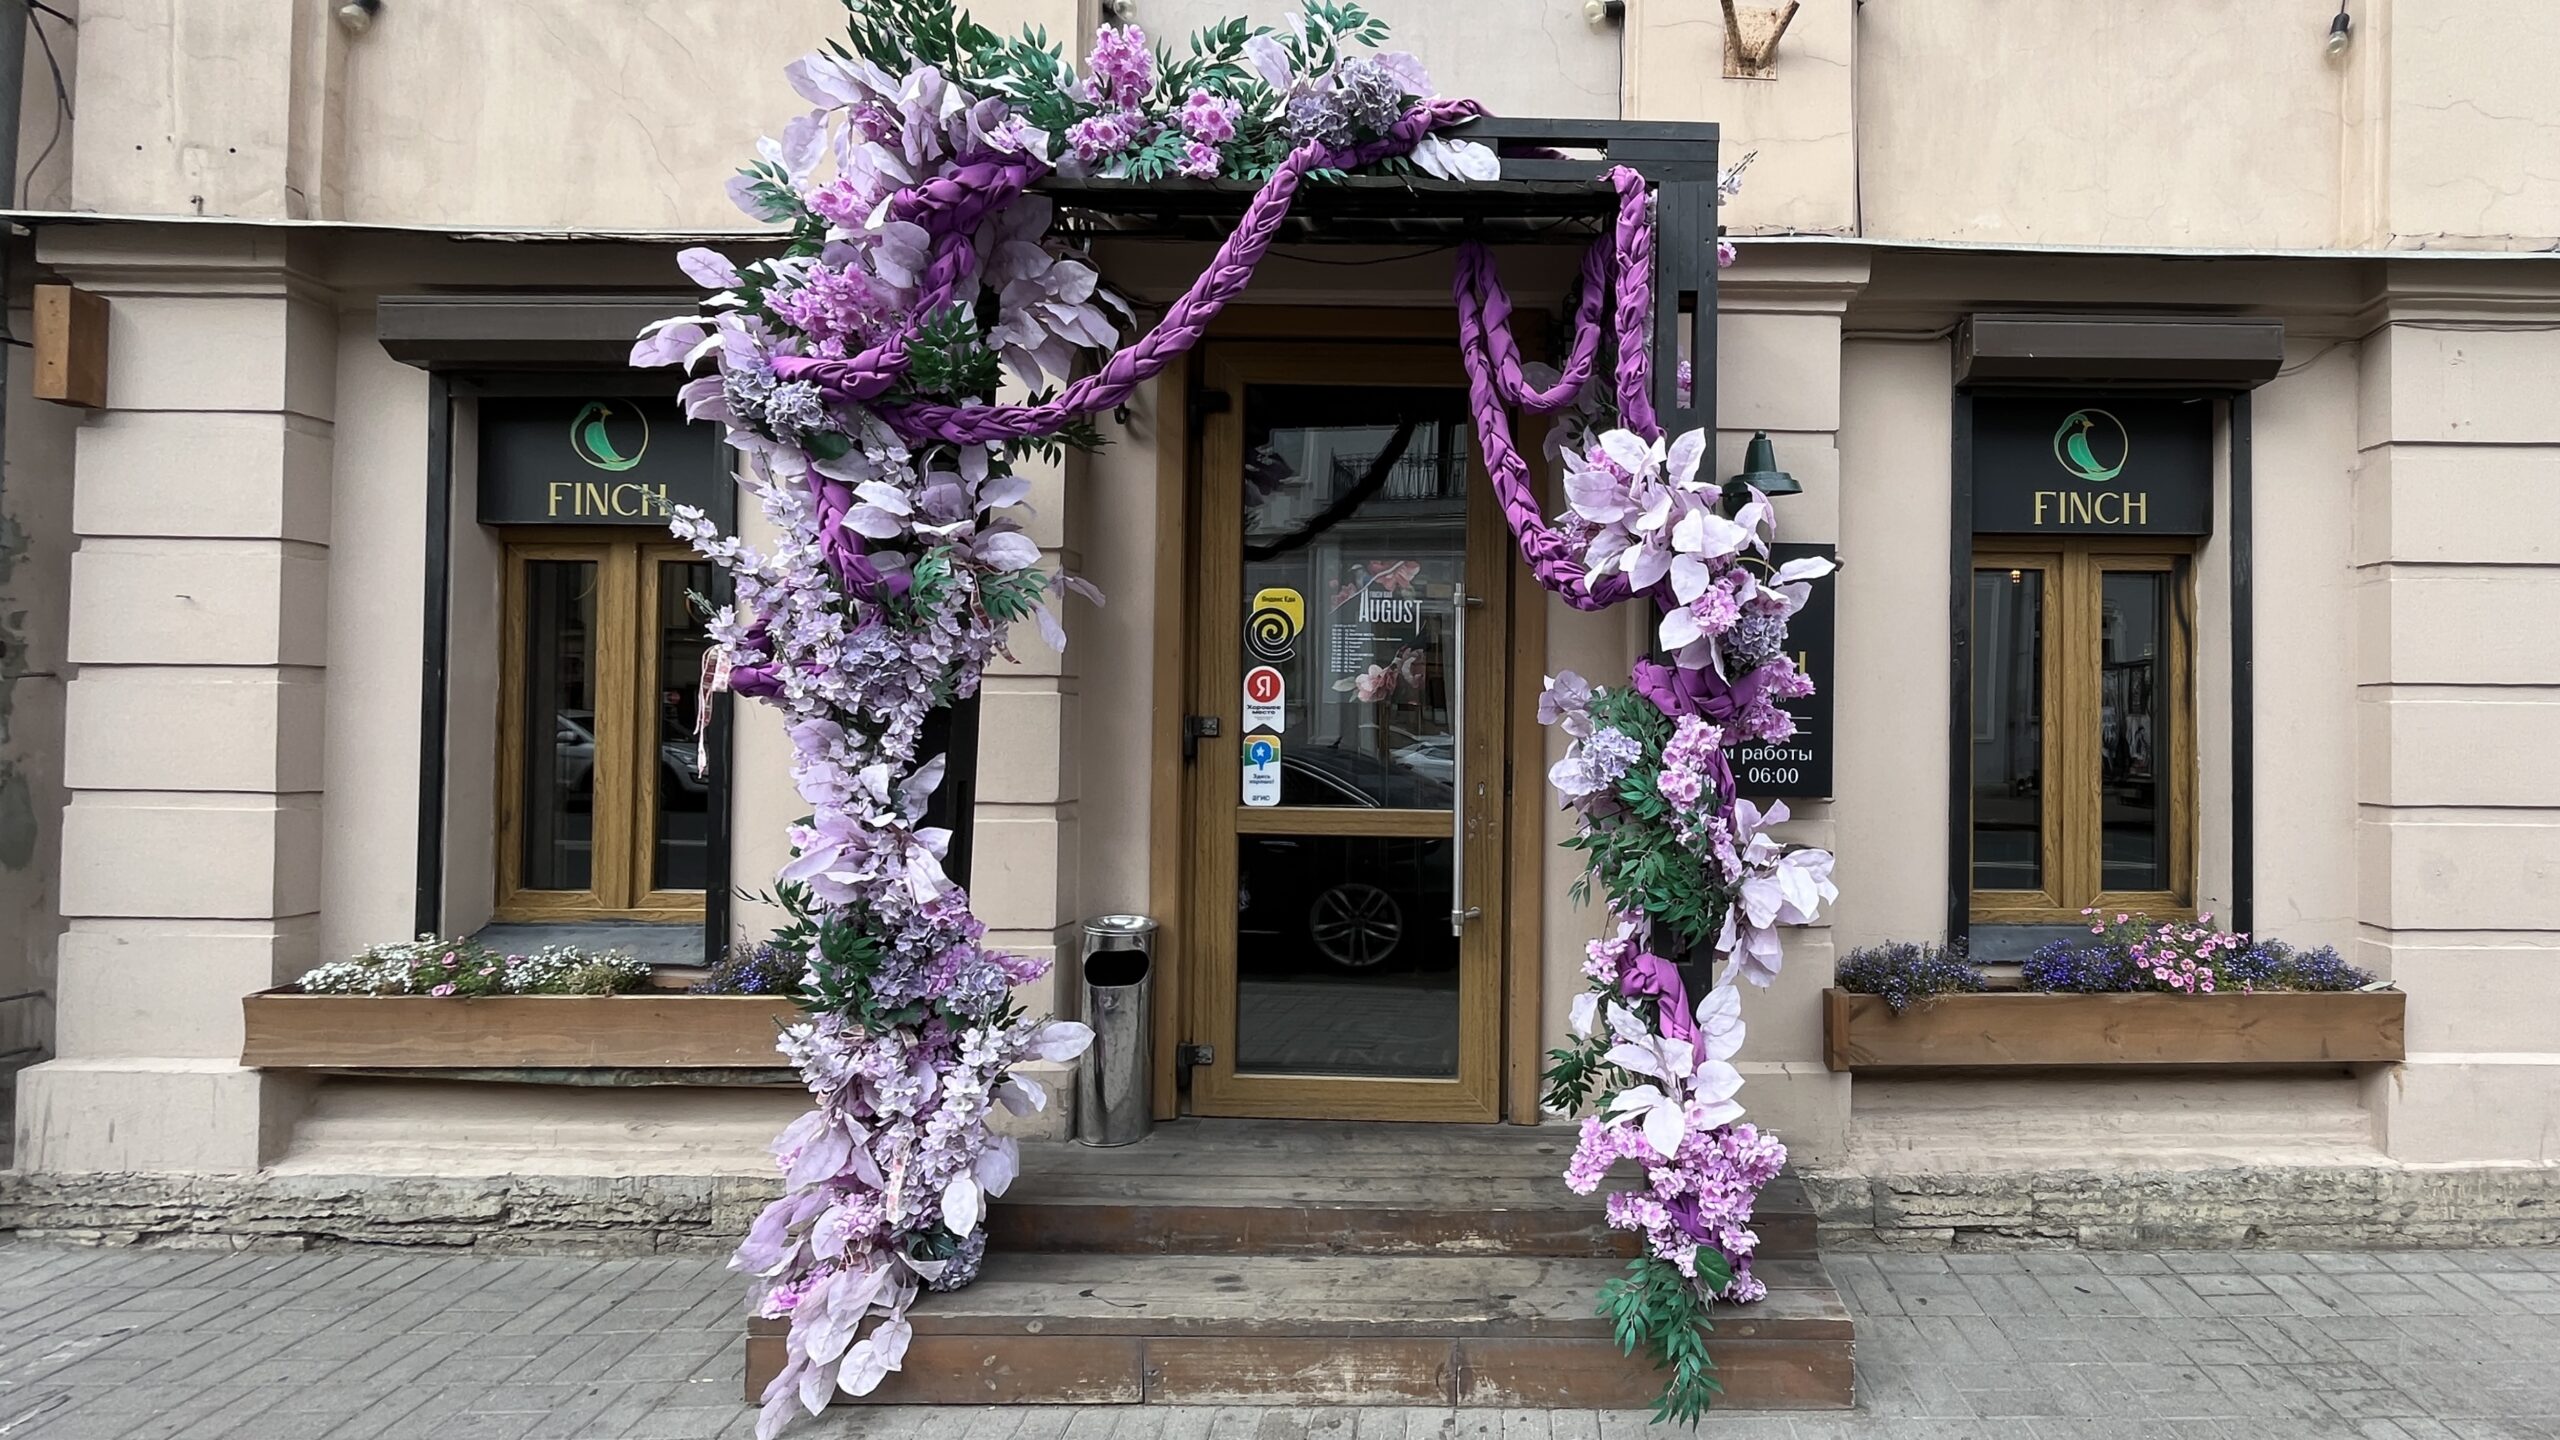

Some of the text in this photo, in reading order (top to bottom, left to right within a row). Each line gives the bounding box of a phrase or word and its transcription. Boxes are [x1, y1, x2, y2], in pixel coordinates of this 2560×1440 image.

[548, 482, 669, 516] FINCH
[2034, 491, 2147, 525] FINCH
[1358, 588, 1423, 637] AUGUST
[1256, 675, 1271, 697] Я
[1742, 745, 1812, 765] работы
[1748, 767, 1799, 784] 06:00
